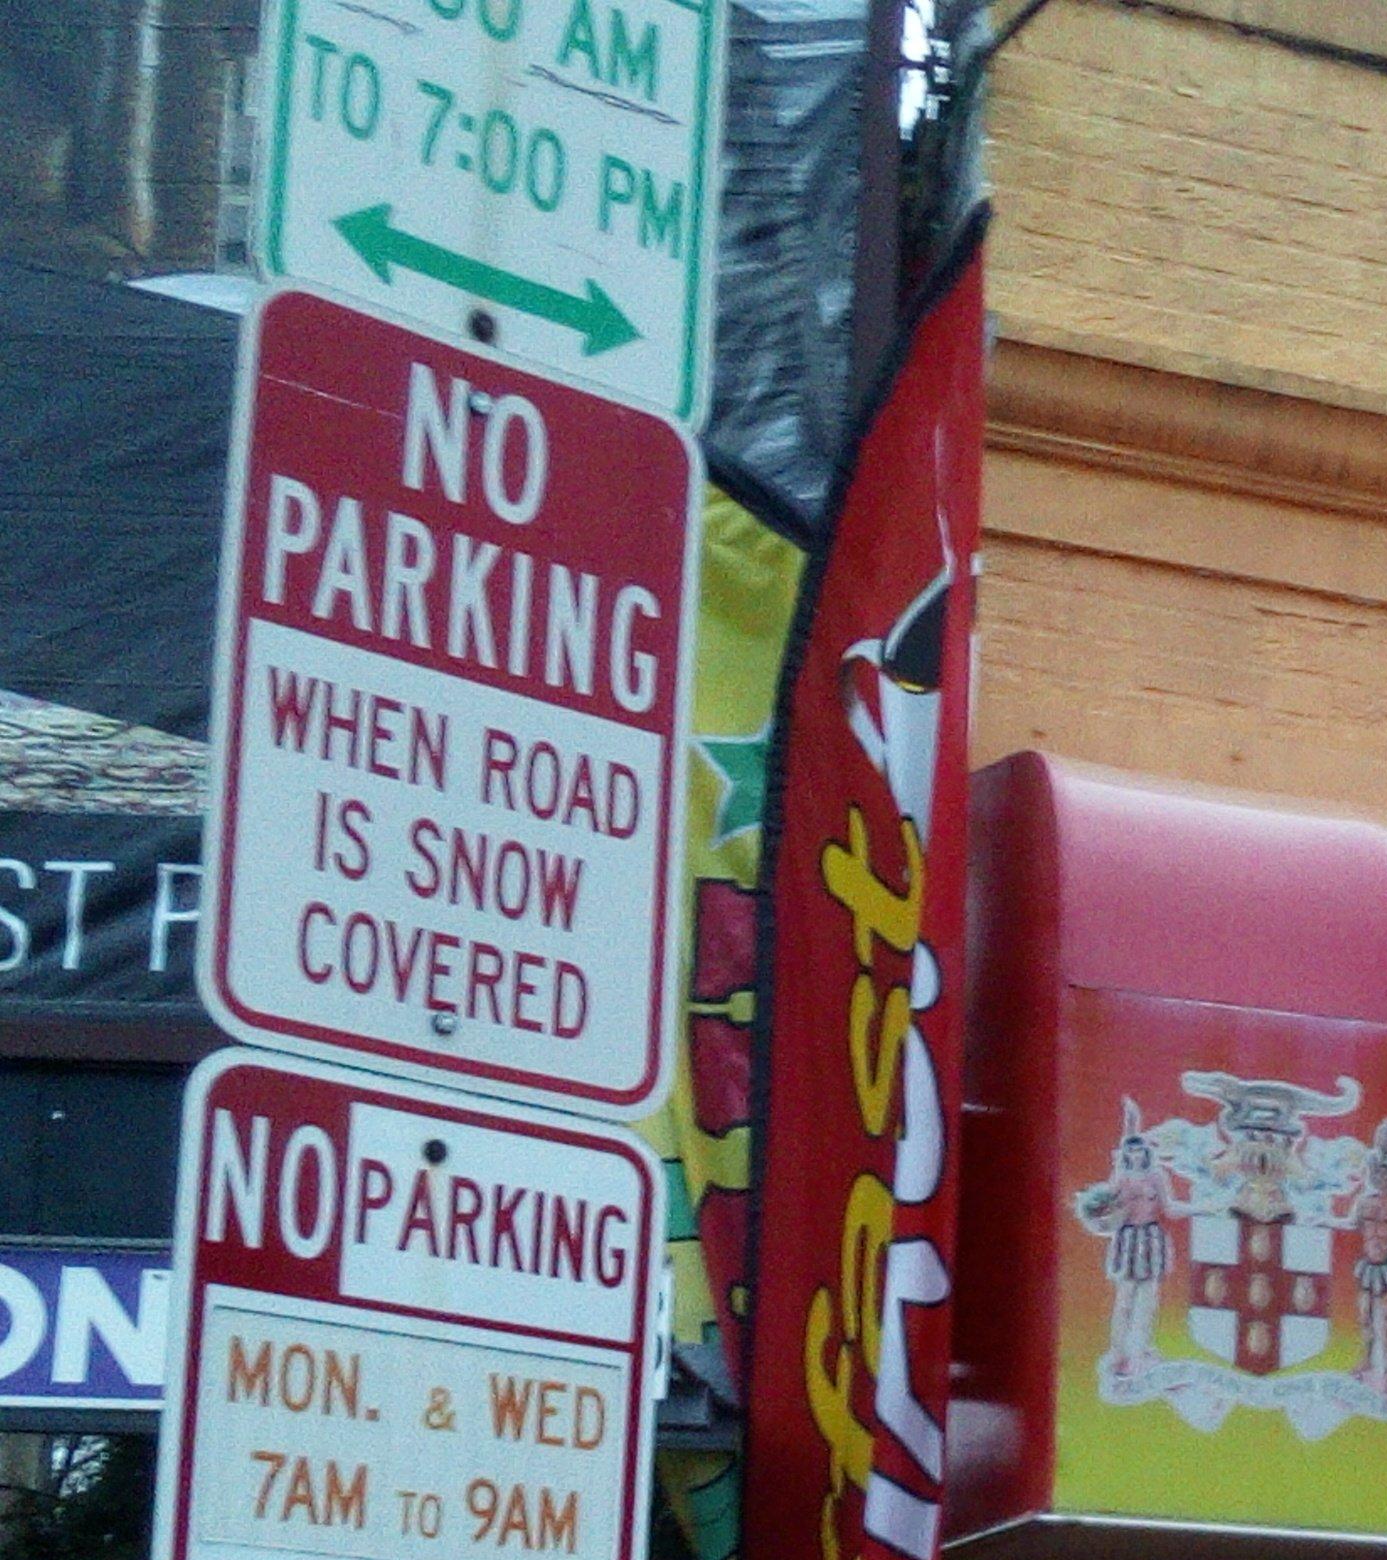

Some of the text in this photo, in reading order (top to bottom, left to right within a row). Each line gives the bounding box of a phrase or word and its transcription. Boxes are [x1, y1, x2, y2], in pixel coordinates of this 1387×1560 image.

[556, 0, 660, 101] AM
[304, 32, 685, 261] TO 7:00 PM
[402, 361, 550, 525] NO
[261, 472, 661, 716] PARKING
[266, 665, 642, 842] WHEN ROAD
[312, 790, 585, 934] IS SNOW
[297, 901, 588, 1041] COVERED
[204, 1107, 632, 1290] NO PARKING
[224, 1333, 607, 1451] MON. & WED
[249, 1449, 581, 1555] 7AM TO 9AM
